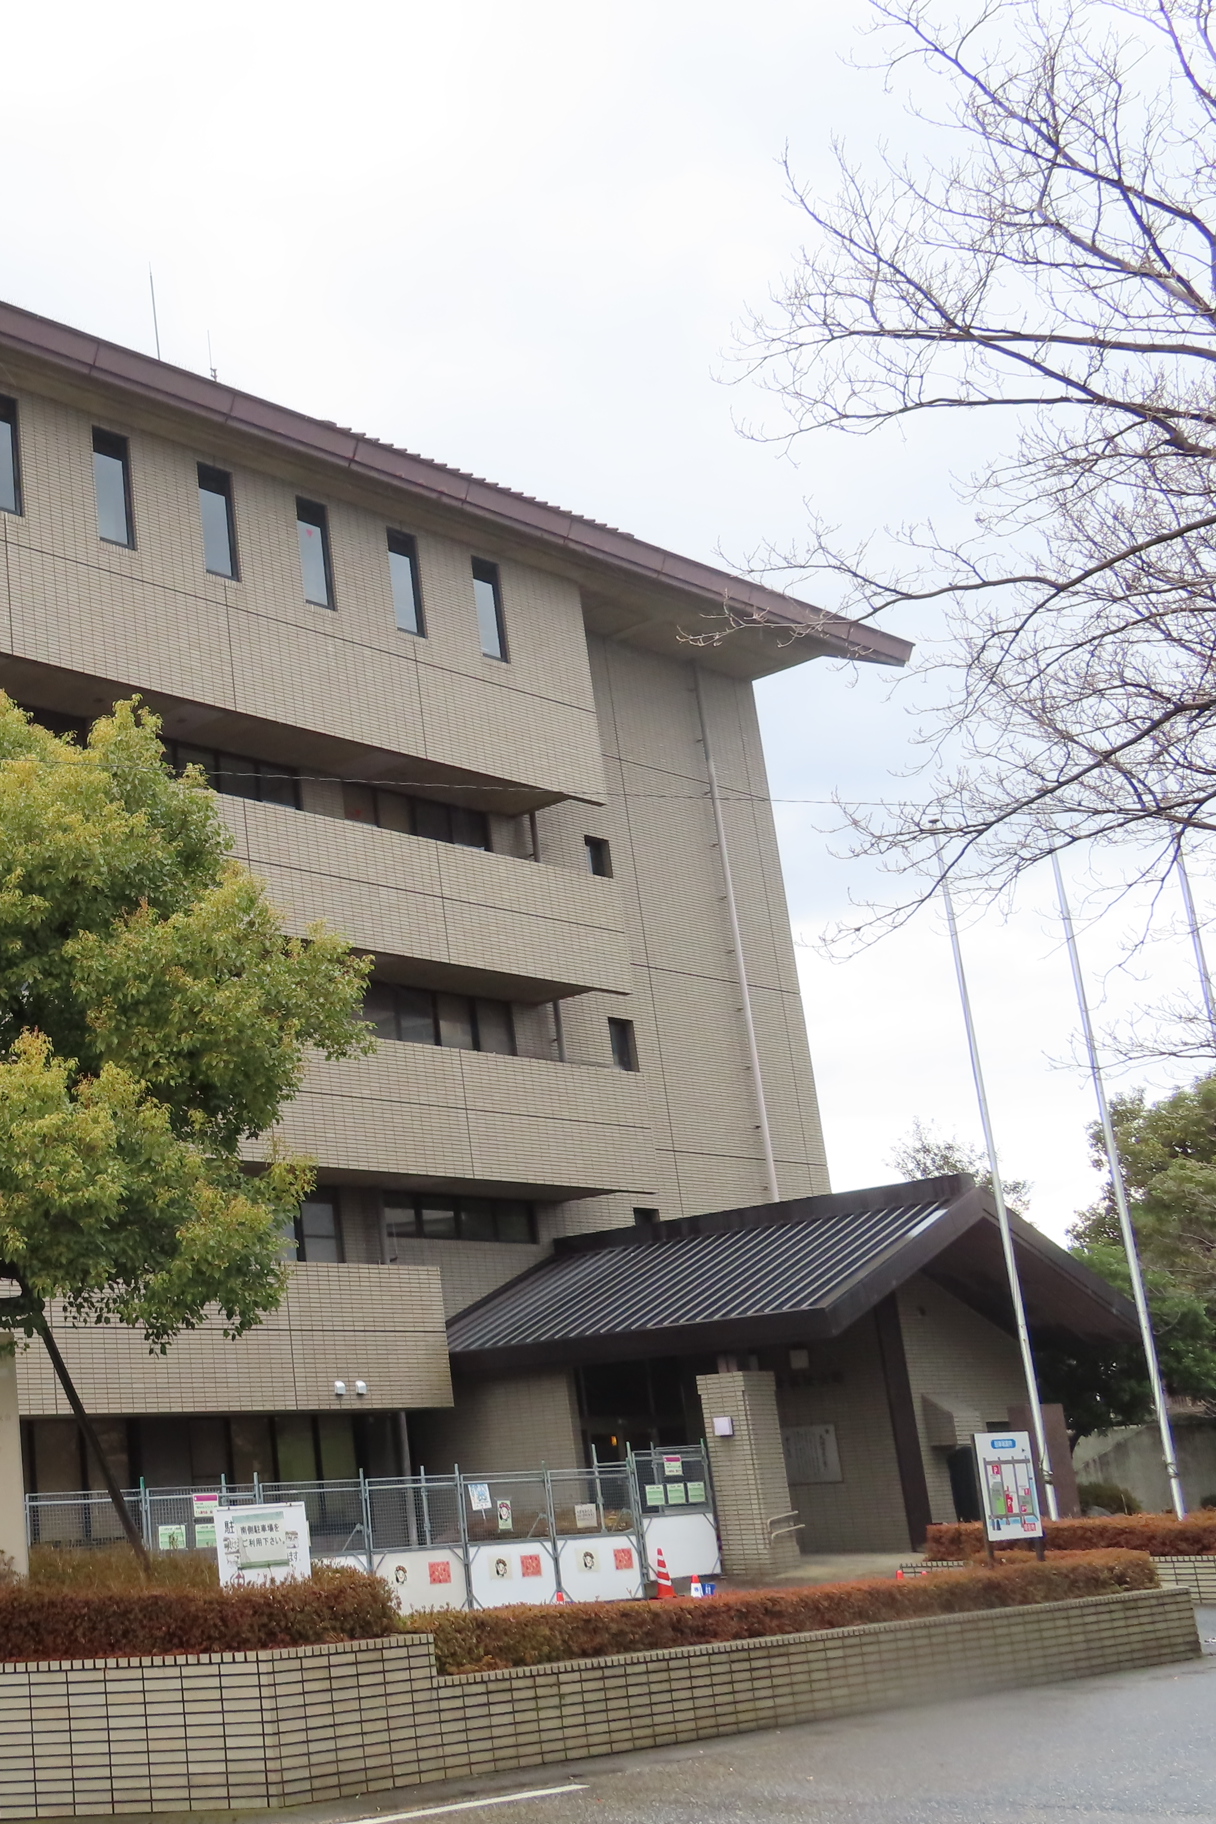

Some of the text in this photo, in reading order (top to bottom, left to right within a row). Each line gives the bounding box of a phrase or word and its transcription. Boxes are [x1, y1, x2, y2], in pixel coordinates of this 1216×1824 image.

[240, 1523, 280, 1536] 南側駐車場を
[242, 1536, 285, 1549] ご利用下さい。
